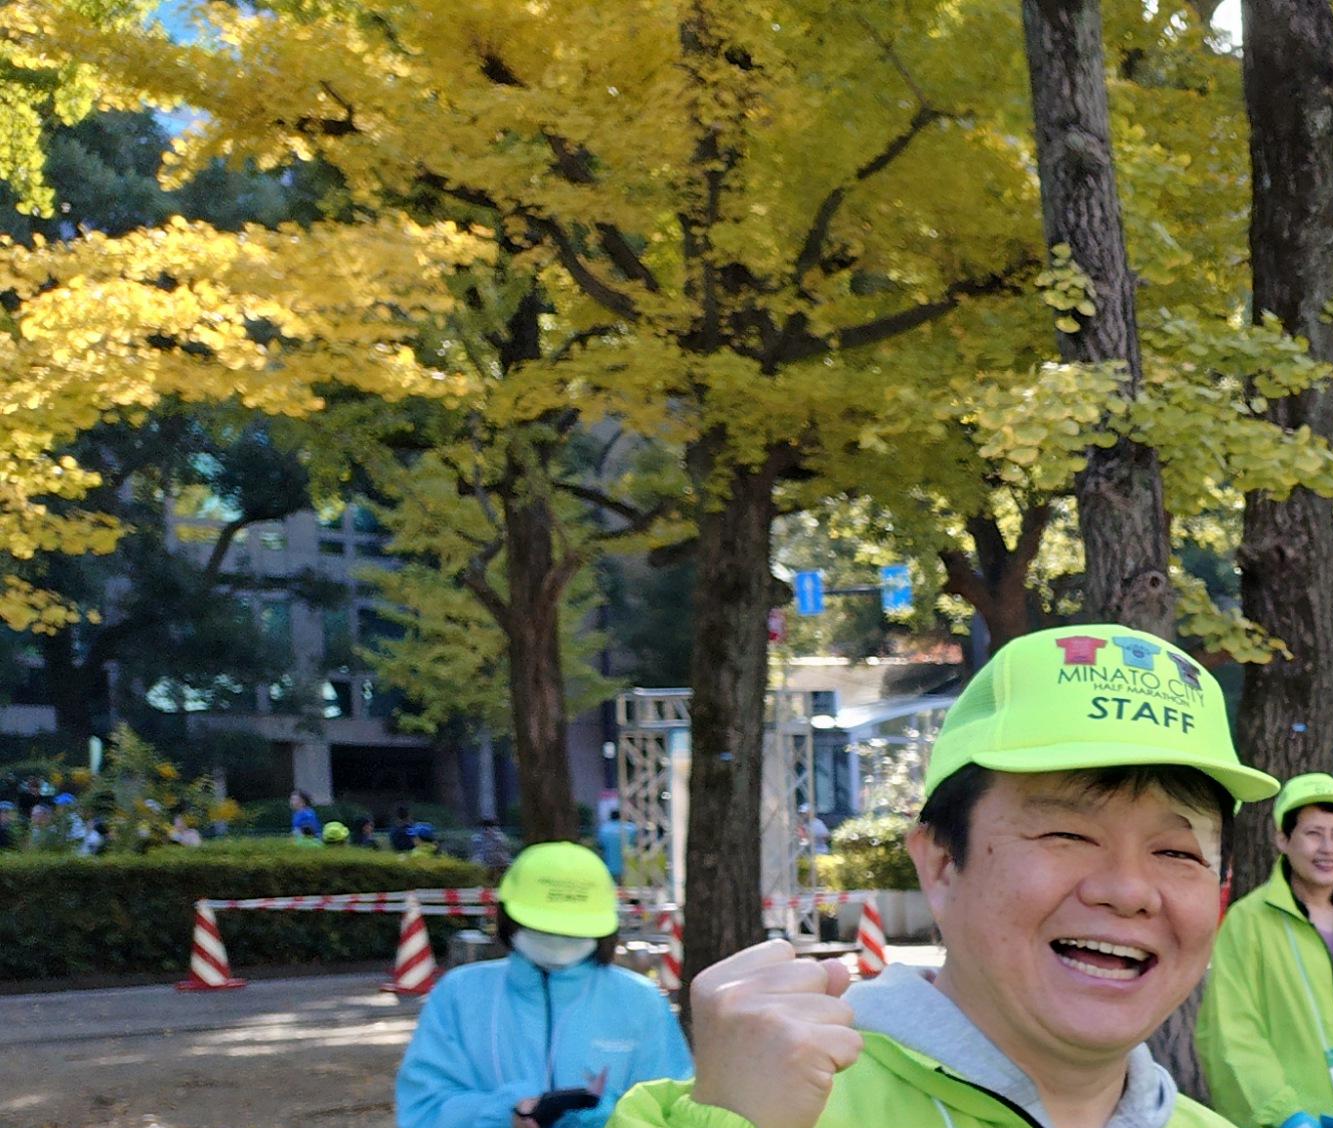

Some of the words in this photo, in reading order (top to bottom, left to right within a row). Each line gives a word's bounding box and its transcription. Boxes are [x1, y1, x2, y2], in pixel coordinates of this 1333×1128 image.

[1057, 665, 1160, 691] MINATO
[1168, 678, 1204, 708] CITY
[1093, 682, 1124, 693] HALF
[1126, 685, 1191, 708] MARATHON
[1087, 696, 1195, 735] STAFF
